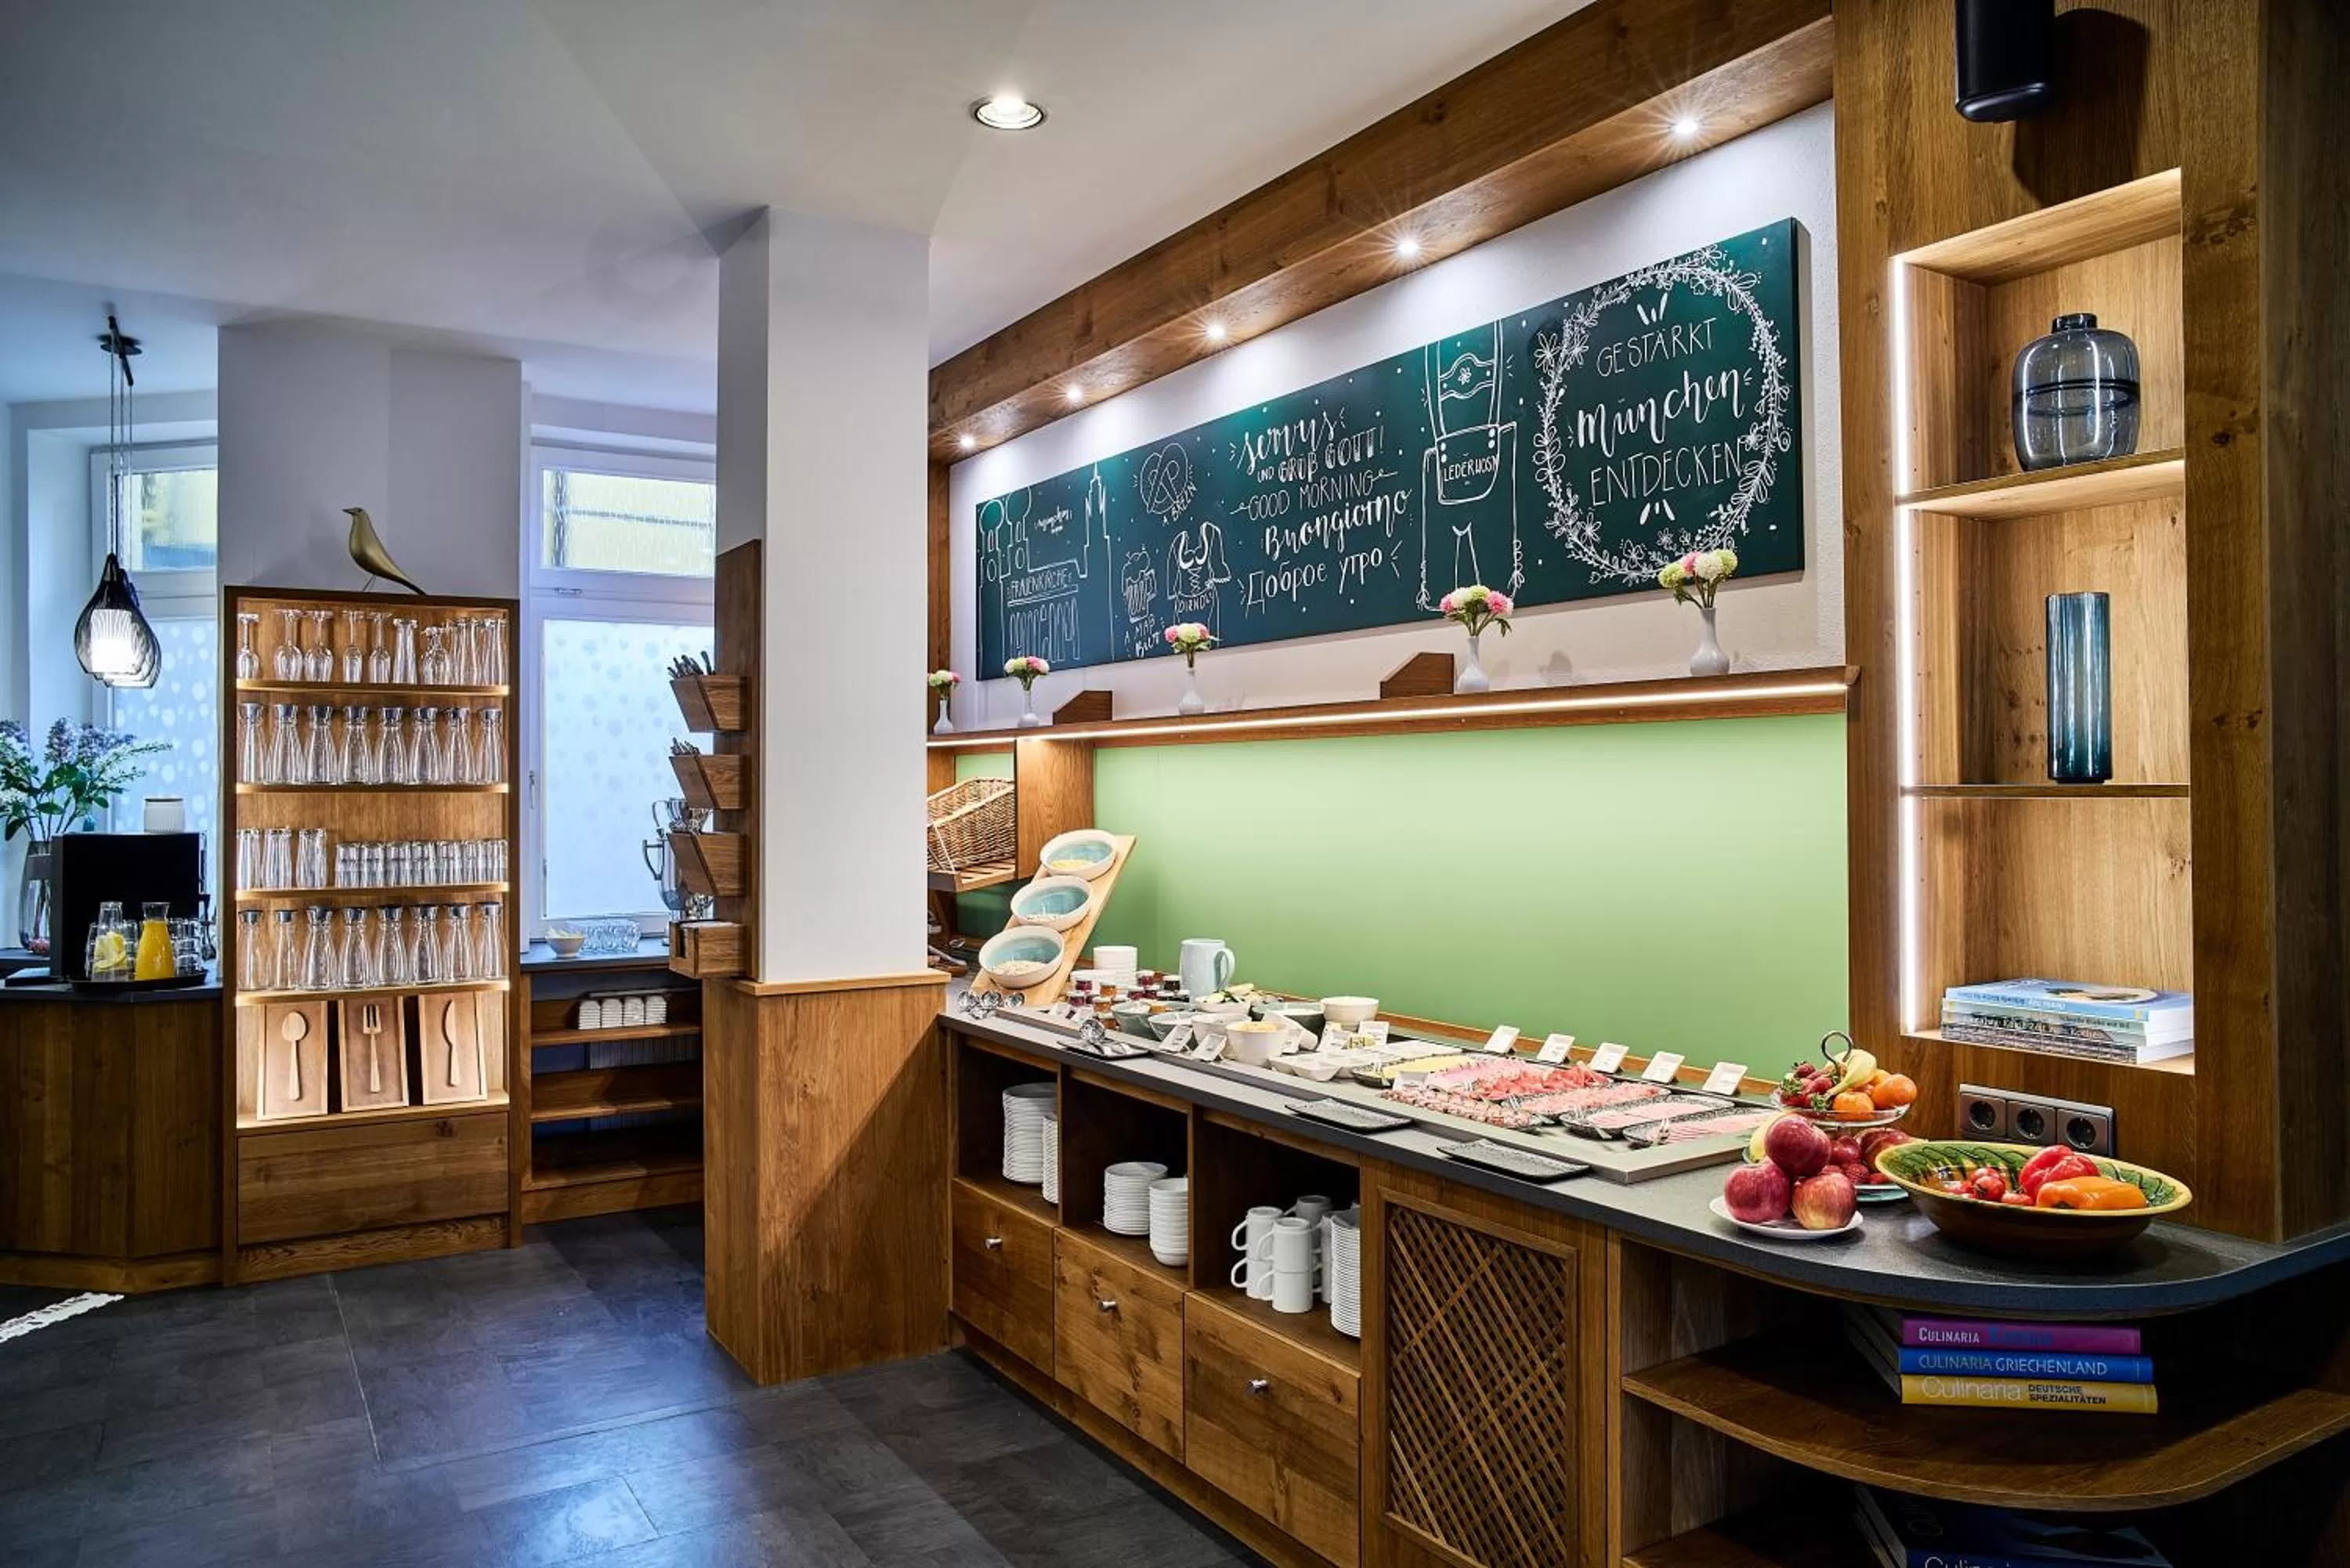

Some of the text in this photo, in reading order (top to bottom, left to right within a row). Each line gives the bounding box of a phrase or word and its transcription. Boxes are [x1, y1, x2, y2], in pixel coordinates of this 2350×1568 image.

[1596, 317, 1717, 378] GESTÄRKT
[1578, 369, 1745, 458] München
[1248, 470, 1374, 521] GOOD MORNING
[1257, 466, 1274, 483] UND
[1591, 436, 1744, 508] ENTDECKEN
[1265, 489, 1412, 561] Buongiorno
[1245, 548, 1383, 619] Доброе утро
[1919, 1354, 2108, 1376] CULINARIA GRIECHENLAND
[1922, 1376, 2021, 1400] Culinaria
[2028, 1384, 2083, 1394] DEUTSCHE
[2030, 1393, 2107, 1405] SPEZIALITÄTEN
